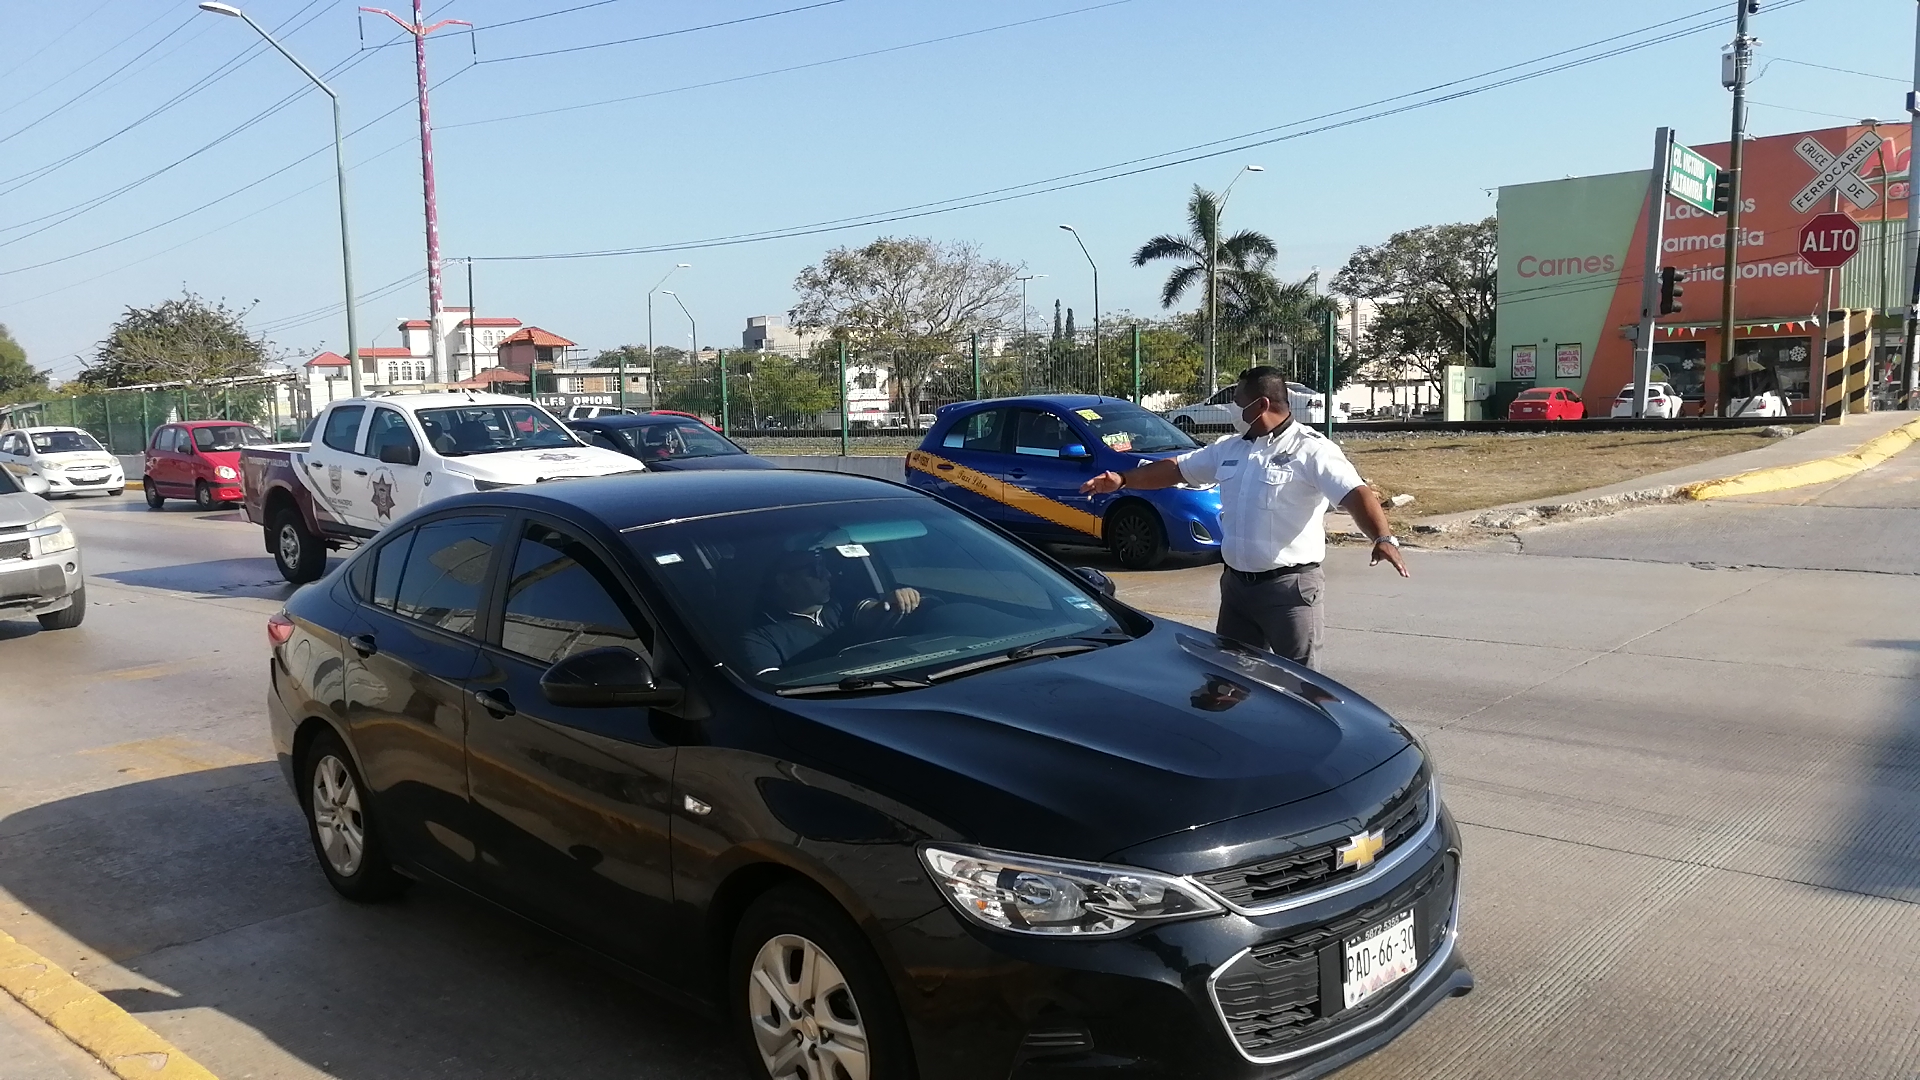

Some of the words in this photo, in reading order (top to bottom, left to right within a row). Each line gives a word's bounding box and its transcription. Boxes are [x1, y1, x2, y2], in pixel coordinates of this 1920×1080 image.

[1801, 142, 1829, 167] CRUCE
[1671, 169, 1703, 203] ALTAMIRA
[1796, 139, 1876, 208] FERROCARRIL
[1846, 183, 1865, 199] DE
[1665, 197, 1756, 221] Lacs
[1662, 227, 1765, 253] armaia
[1802, 228, 1856, 253] ALTO
[1517, 254, 1615, 278] Carnes
[573, 395, 613, 406] ORION
[1347, 924, 1415, 986] PAD-66-30
